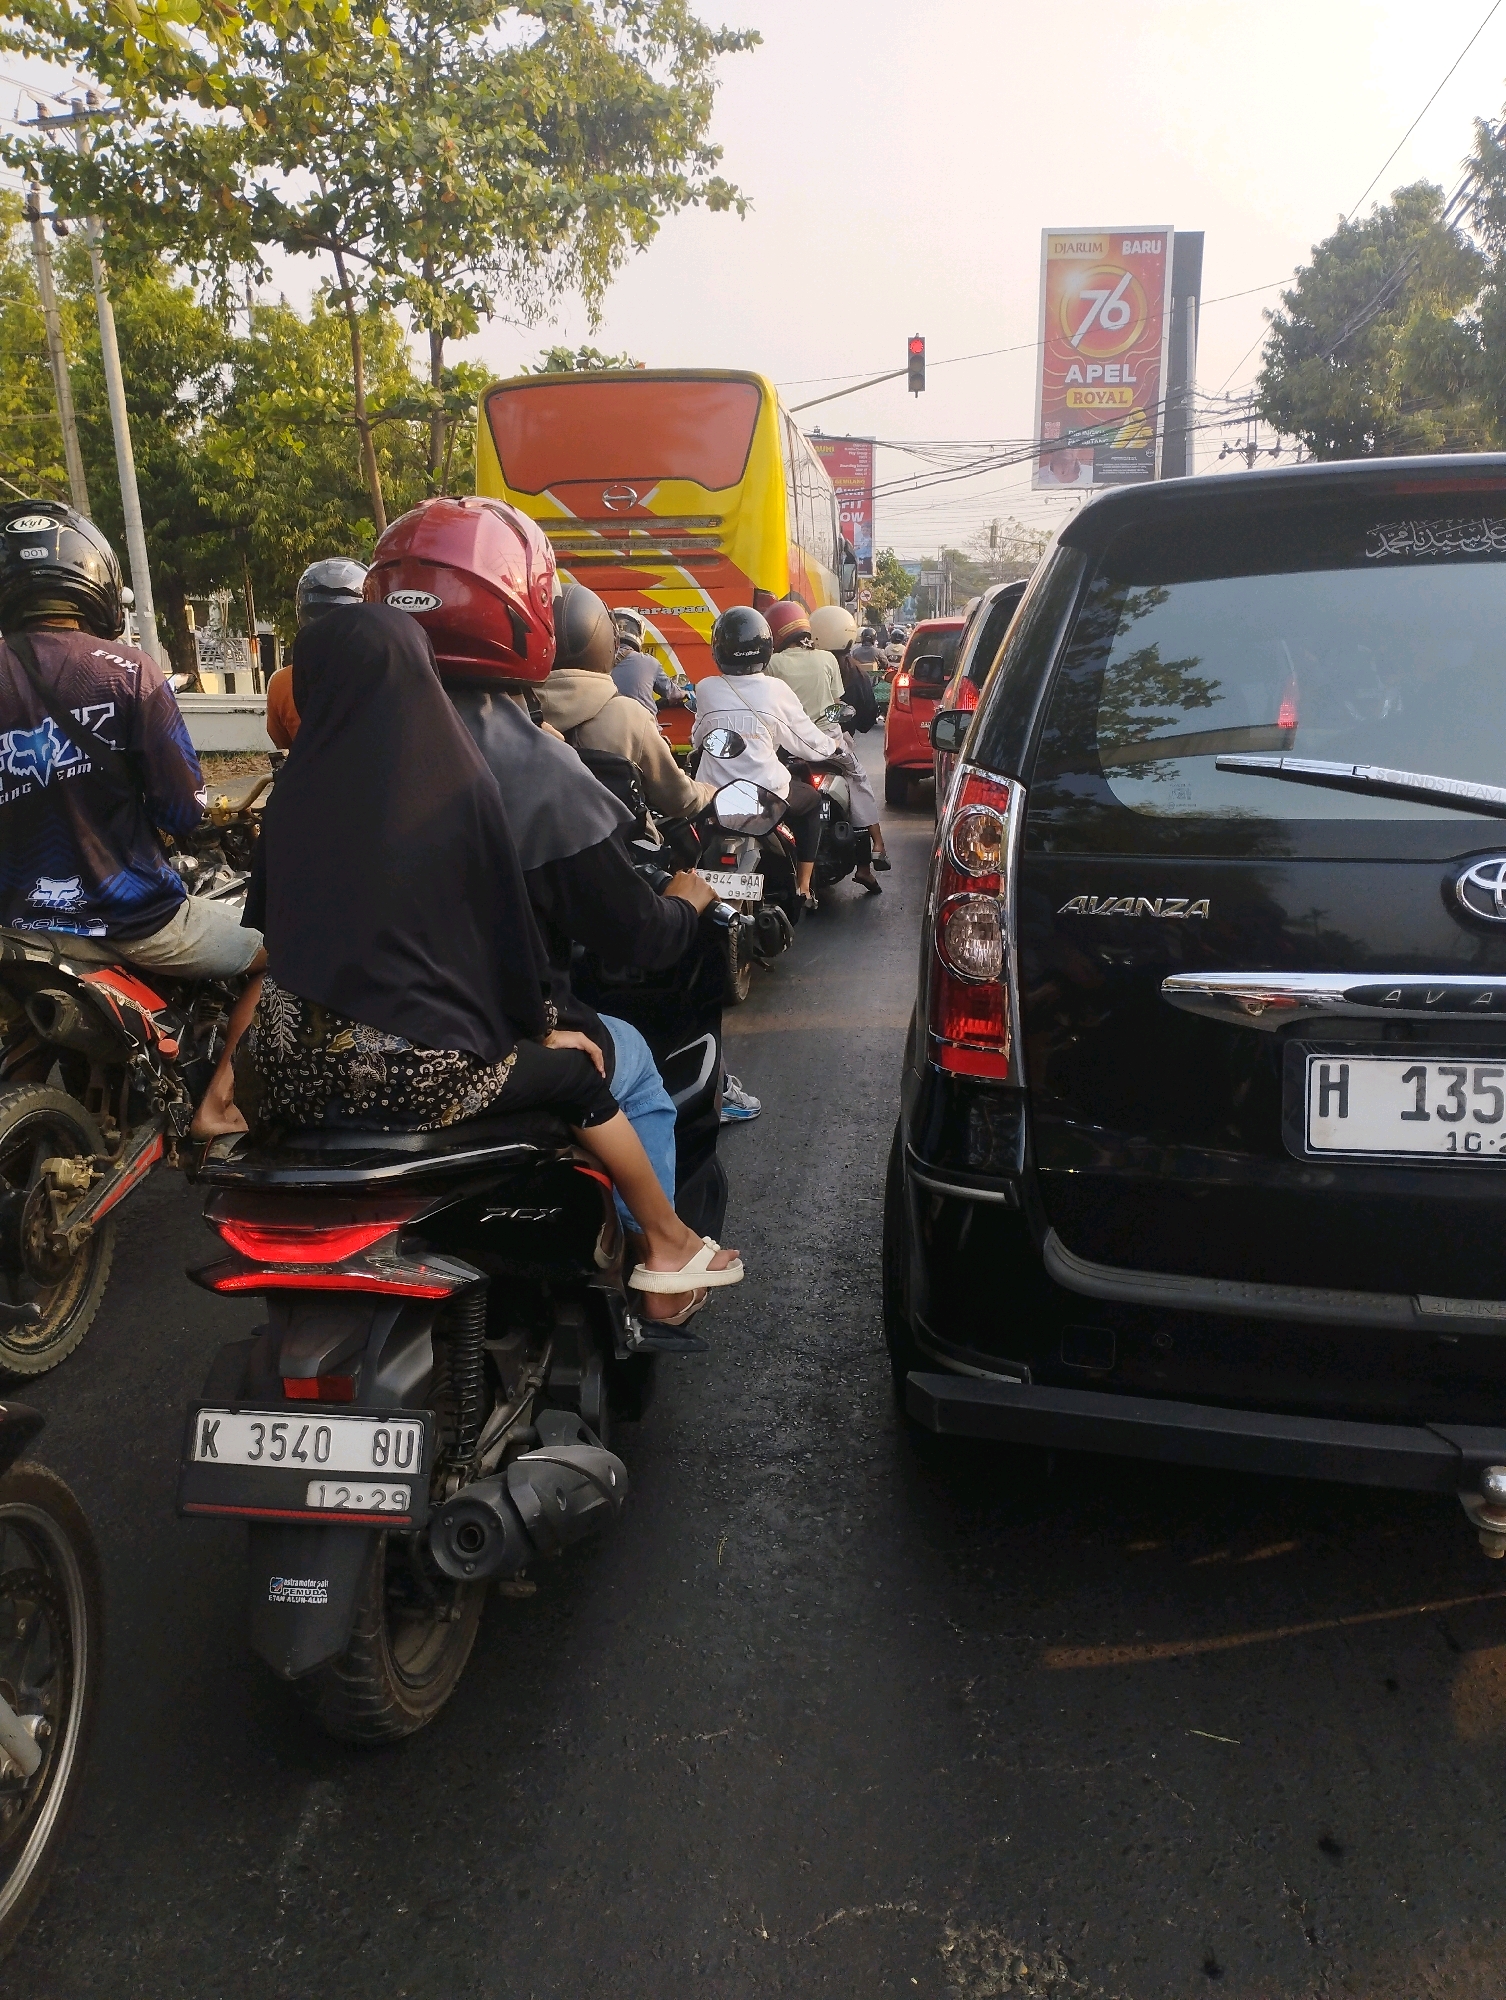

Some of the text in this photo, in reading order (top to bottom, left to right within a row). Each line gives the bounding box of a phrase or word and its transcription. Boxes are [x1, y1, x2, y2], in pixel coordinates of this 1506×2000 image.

[1054, 242, 1103, 254] DJARUM
[1122, 239, 1162, 256] BARU
[1071, 271, 1133, 349] 76
[1065, 363, 1137, 384] APEL
[1072, 390, 1128, 405] ROYAL
[391, 596, 430, 606] KCM
[1057, 895, 1210, 919] AVANZA
[1319, 1063, 1506, 1124] H 135
[480, 1206, 563, 1222] PCX
[200, 1418, 221, 1458] K
[247, 1422, 332, 1463] 3540
[283, 1588, 327, 1596] PEMUDA
